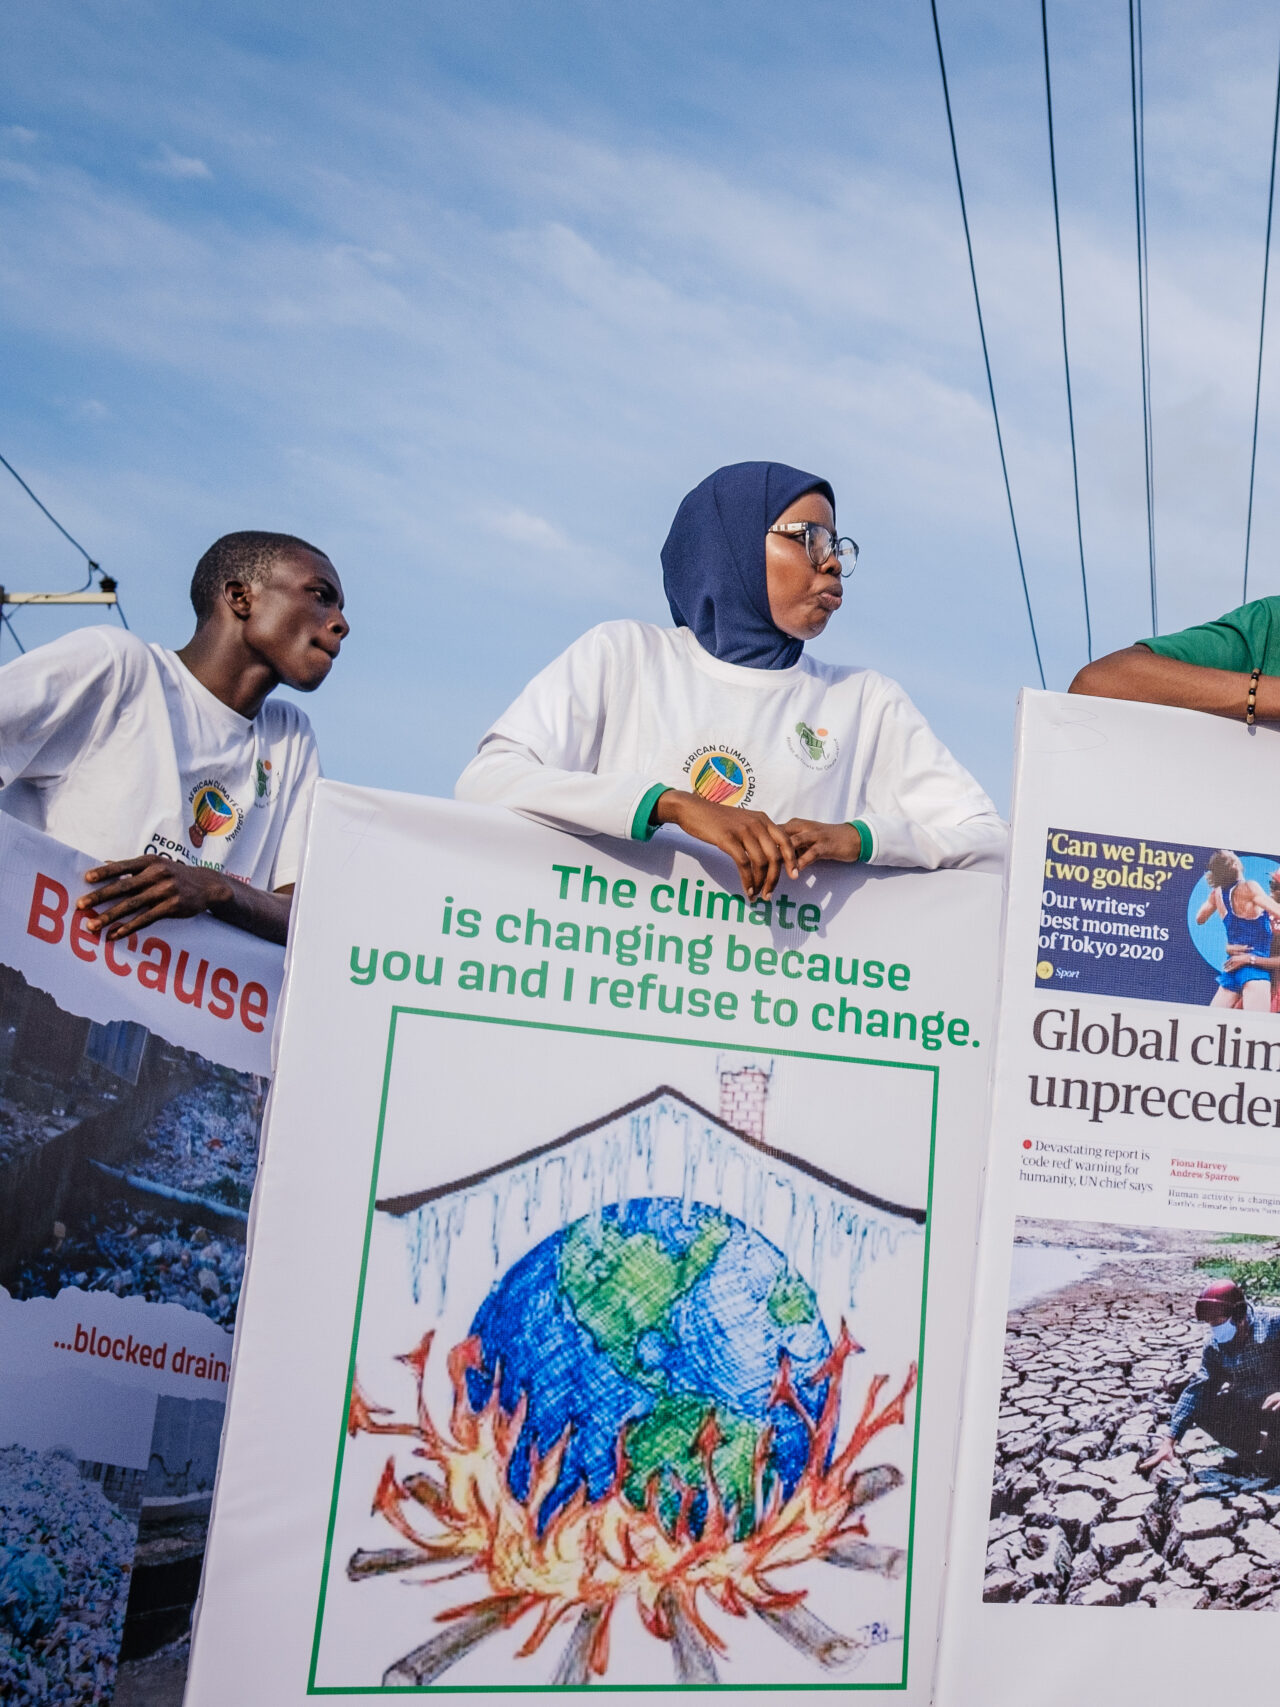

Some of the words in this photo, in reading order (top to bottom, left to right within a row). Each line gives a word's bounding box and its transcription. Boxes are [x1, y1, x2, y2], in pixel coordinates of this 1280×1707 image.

[682, 744, 716, 774] AFRICAN
[718, 744, 754, 774] CLIMATE
[188, 779, 213, 803] AFRICAN
[214, 780, 237, 807] CLIMATE
[225, 807, 244, 842] CARAVAN
[152, 833, 191, 859] PEOPLE
[1102, 843, 1134, 863] we
[1139, 842, 1194, 870] have
[1044, 858, 1089, 881] two
[552, 864, 637, 909] The
[650, 877, 822, 934] climate
[1041, 890, 1077, 910] Our
[1040, 911, 1080, 931] best
[1082, 917, 1169, 941] moments
[26, 871, 269, 1033] Because
[441, 896, 481, 940] is
[496, 908, 713, 975] changing
[728, 934, 911, 992] because
[1038, 932, 1058, 950] of
[1058, 934, 1117, 959] Tokyo
[1119, 943, 1164, 962] 2020
[1055, 967, 1080, 979] Sport
[349, 944, 443, 987] you
[458, 959, 548, 1000] and
[564, 966, 574, 1002] I
[589, 973, 739, 1021] refuse
[751, 988, 799, 1028] to
[812, 997, 981, 1052] change.
[1032, 1008, 1180, 1063] Global
[1035, 1140, 1102, 1158] Devastating
[1104, 1148, 1138, 1160] report
[1141, 1149, 1150, 1160] is
[1075, 1161, 1122, 1176] warning
[1124, 1163, 1139, 1175] for
[1170, 1159, 1195, 1168] Fiona
[1196, 1160, 1227, 1172] Harvey
[1170, 1169, 1204, 1179] Andrew
[1205, 1171, 1240, 1182] Sparrow
[1080, 1175, 1097, 1187] UN
[1100, 1178, 1128, 1190] chief
[1129, 1181, 1153, 1193] says
[1168, 1189, 1199, 1199] Human
[1202, 1191, 1234, 1202] activity
[171, 1346, 231, 1383] drain
